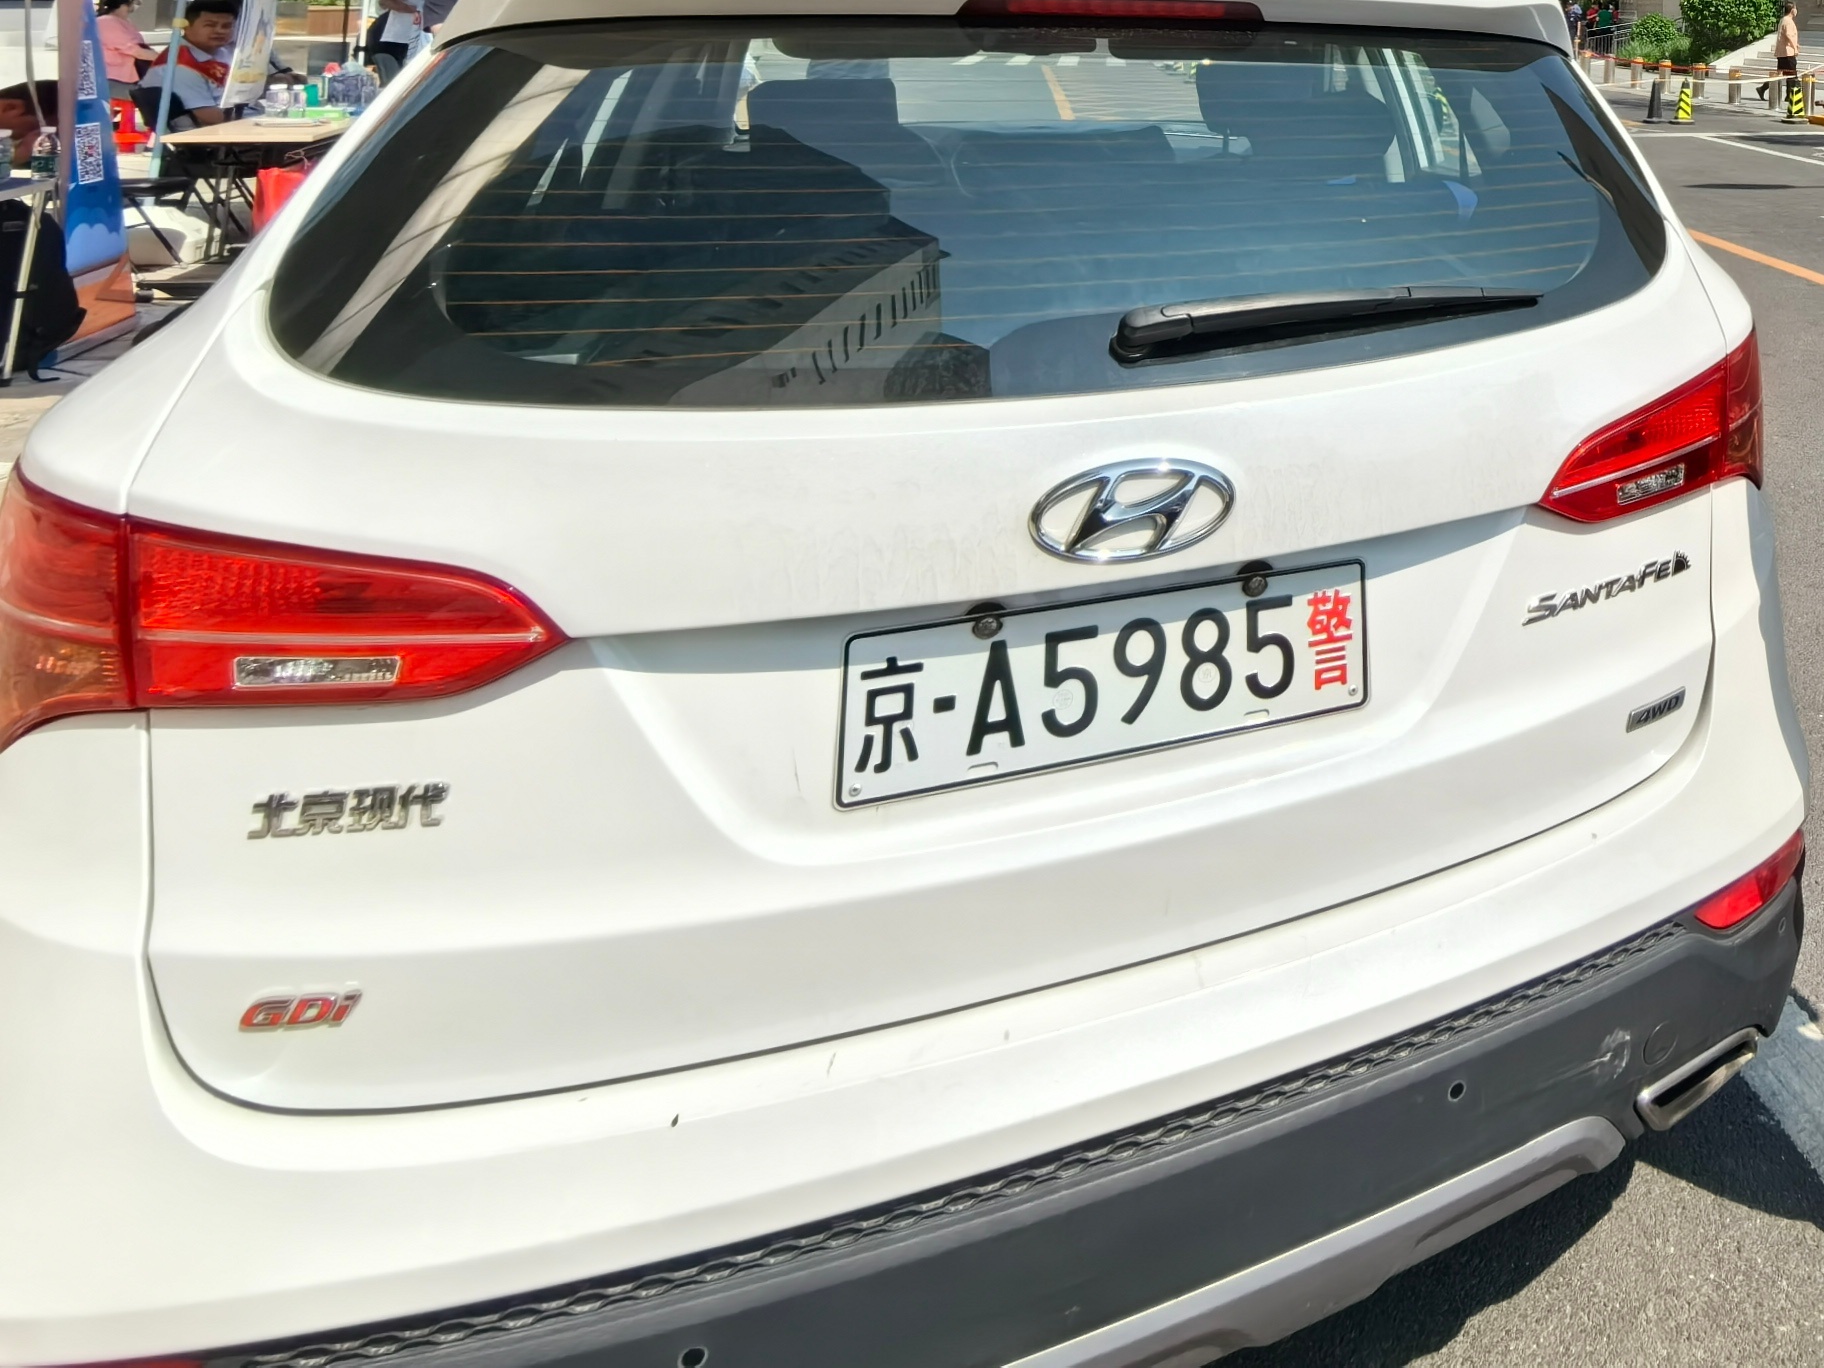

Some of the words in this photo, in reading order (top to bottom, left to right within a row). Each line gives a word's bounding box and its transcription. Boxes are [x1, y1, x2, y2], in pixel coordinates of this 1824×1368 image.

[1635, 694, 1681, 725] 4WD
[247, 781, 450, 840] 北京现代
[238, 983, 363, 1033] GDi
